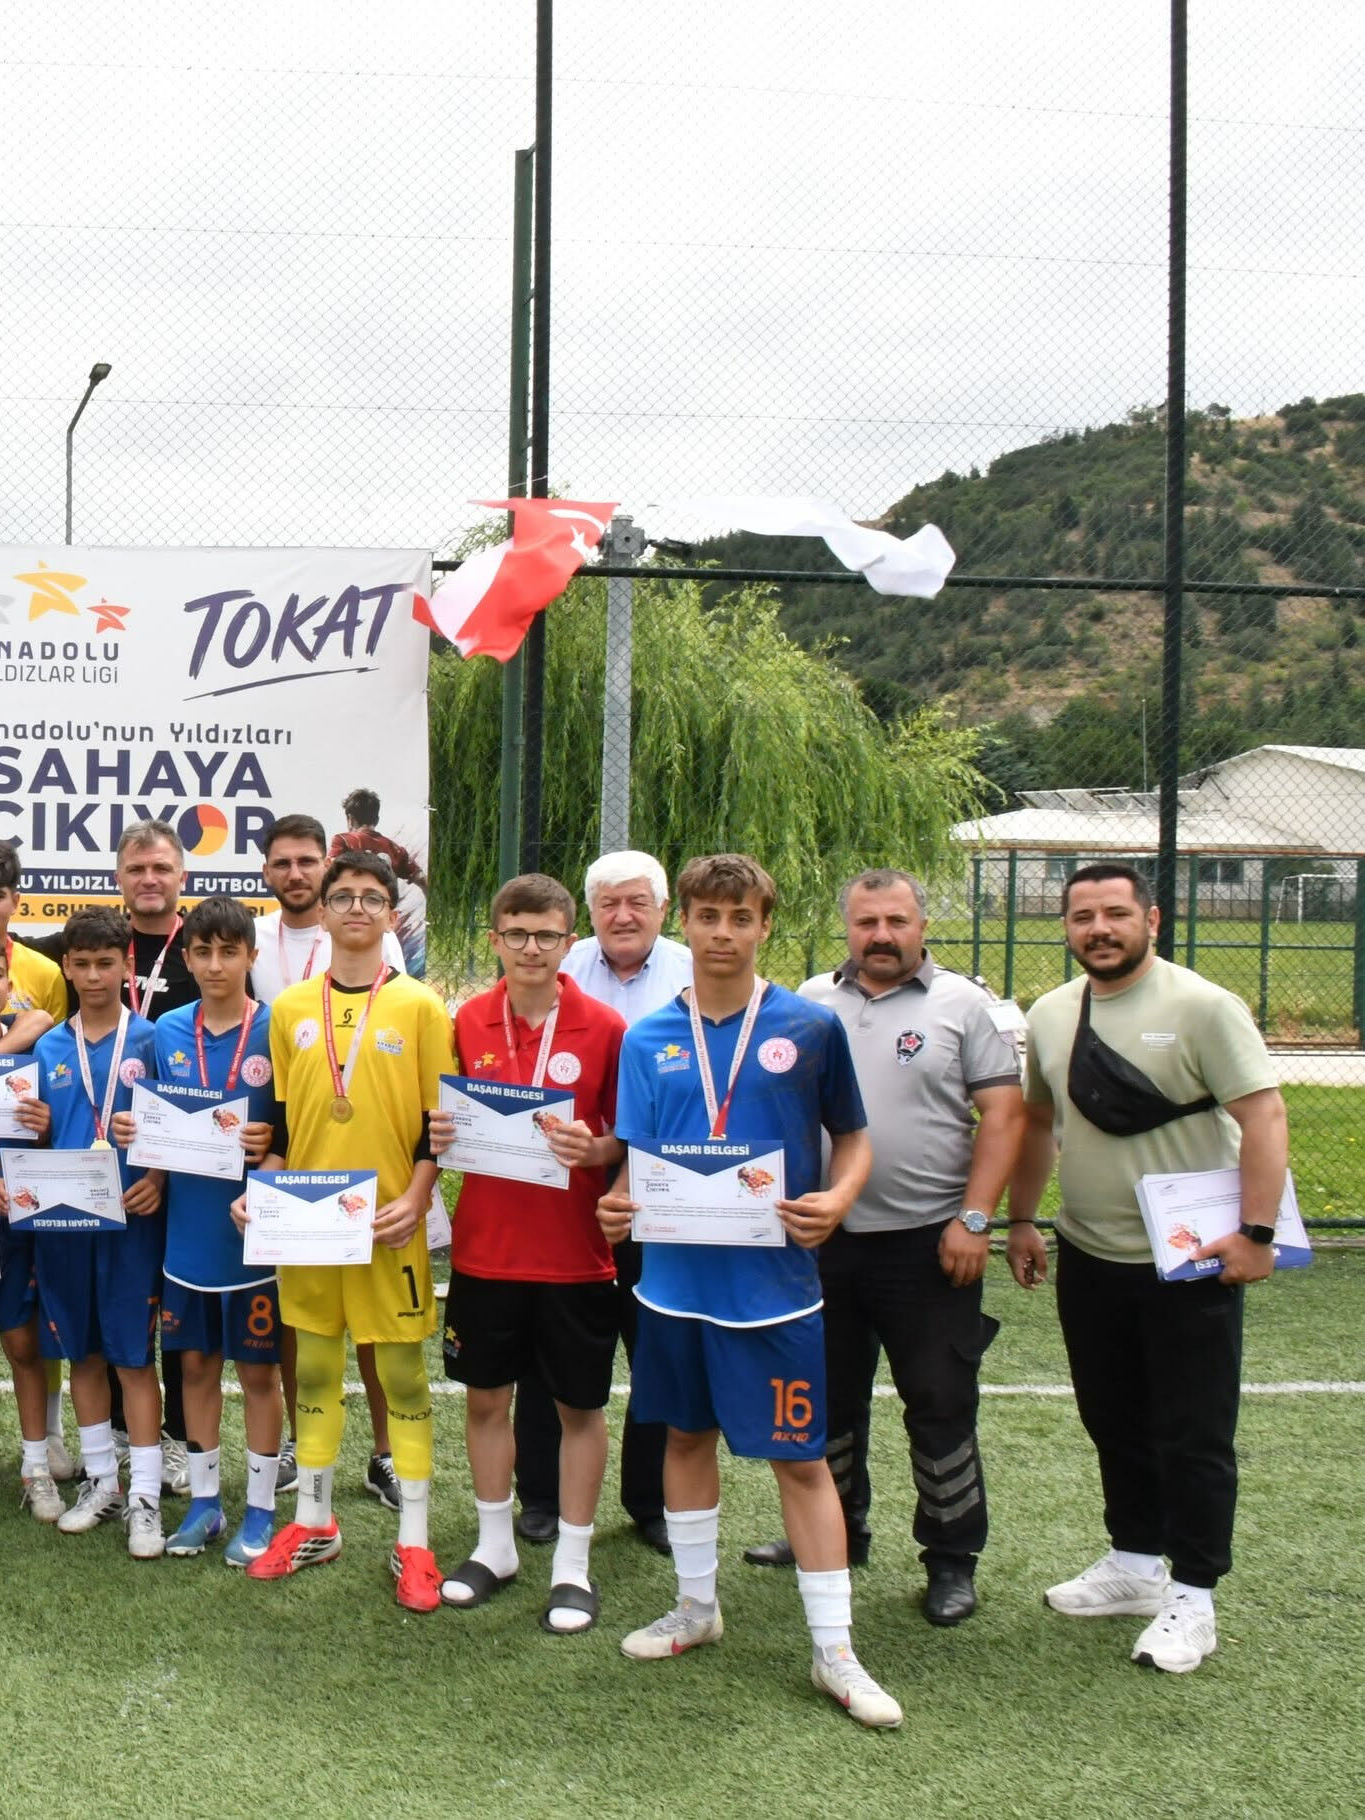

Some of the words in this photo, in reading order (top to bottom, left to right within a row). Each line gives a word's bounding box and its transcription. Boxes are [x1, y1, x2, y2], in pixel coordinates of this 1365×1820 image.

[184, 584, 414, 680] TOKAT
[193, 877, 268, 893] FUTBOL
[19, 903, 35, 917] 3.
[157, 1084, 187, 1095] BAŞARI
[188, 1087, 223, 1099] BELGESİ
[467, 1083, 502, 1095] BAŞARI
[503, 1088, 544, 1101] BELGESİ
[661, 1145, 702, 1156] BAŞARI
[704, 1144, 749, 1156] BELGESİ
[275, 1175, 309, 1185] BAŞARI
[311, 1173, 349, 1184] BELGESİ
[402, 1265, 419, 1309] 1
[247, 1295, 274, 1337] 8
[770, 1378, 813, 1428] 16
